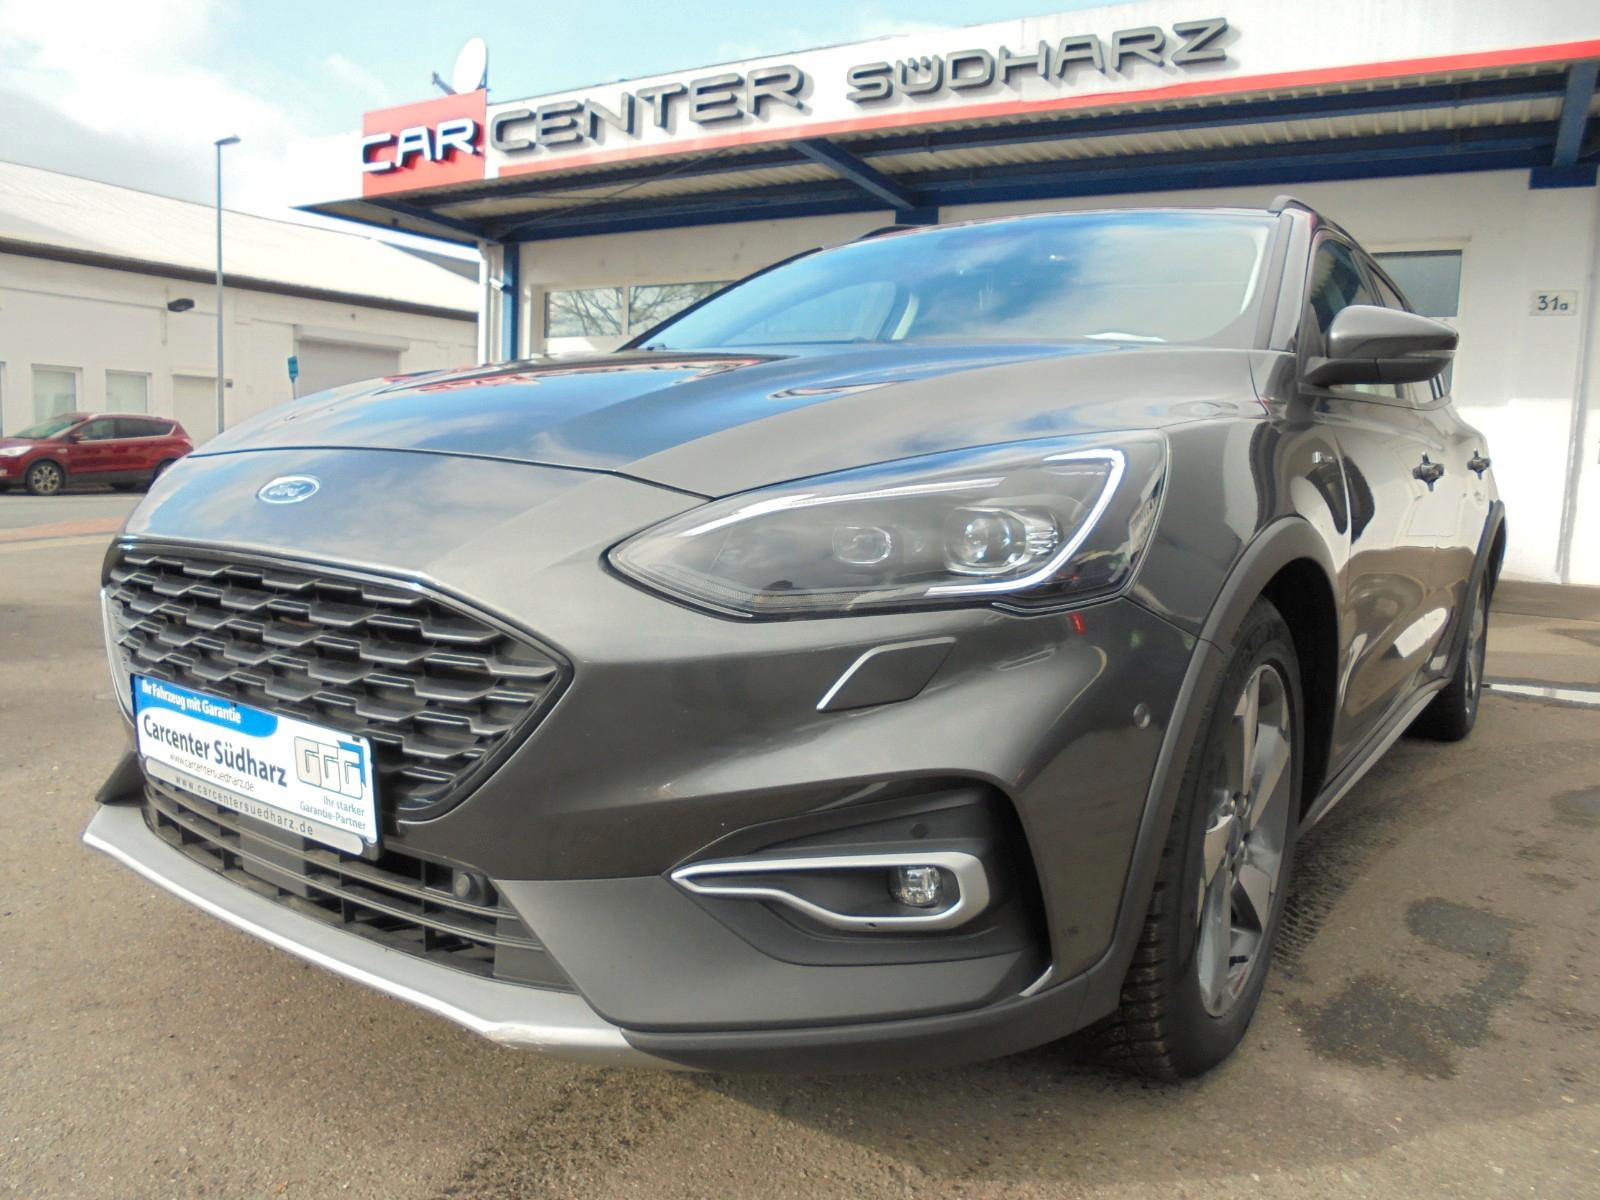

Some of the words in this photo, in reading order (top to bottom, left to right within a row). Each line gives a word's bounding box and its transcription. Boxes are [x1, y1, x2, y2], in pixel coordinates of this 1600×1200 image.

[846, 17, 1230, 103] SÜDHARZ
[1537, 295, 1569, 311] 31a
[152, 683, 186, 711] Fahrzeug
[186, 697, 201, 712] mit
[201, 699, 242, 724] Garantie
[143, 713, 210, 760] Carcenter
[214, 739, 288, 788] Südharz
[175, 775, 313, 836] www.carcentersuedharz.de
[300, 800, 367, 831] Garantie-Partner
[323, 795, 335, 808] Ihr
[336, 799, 366, 818] starker
